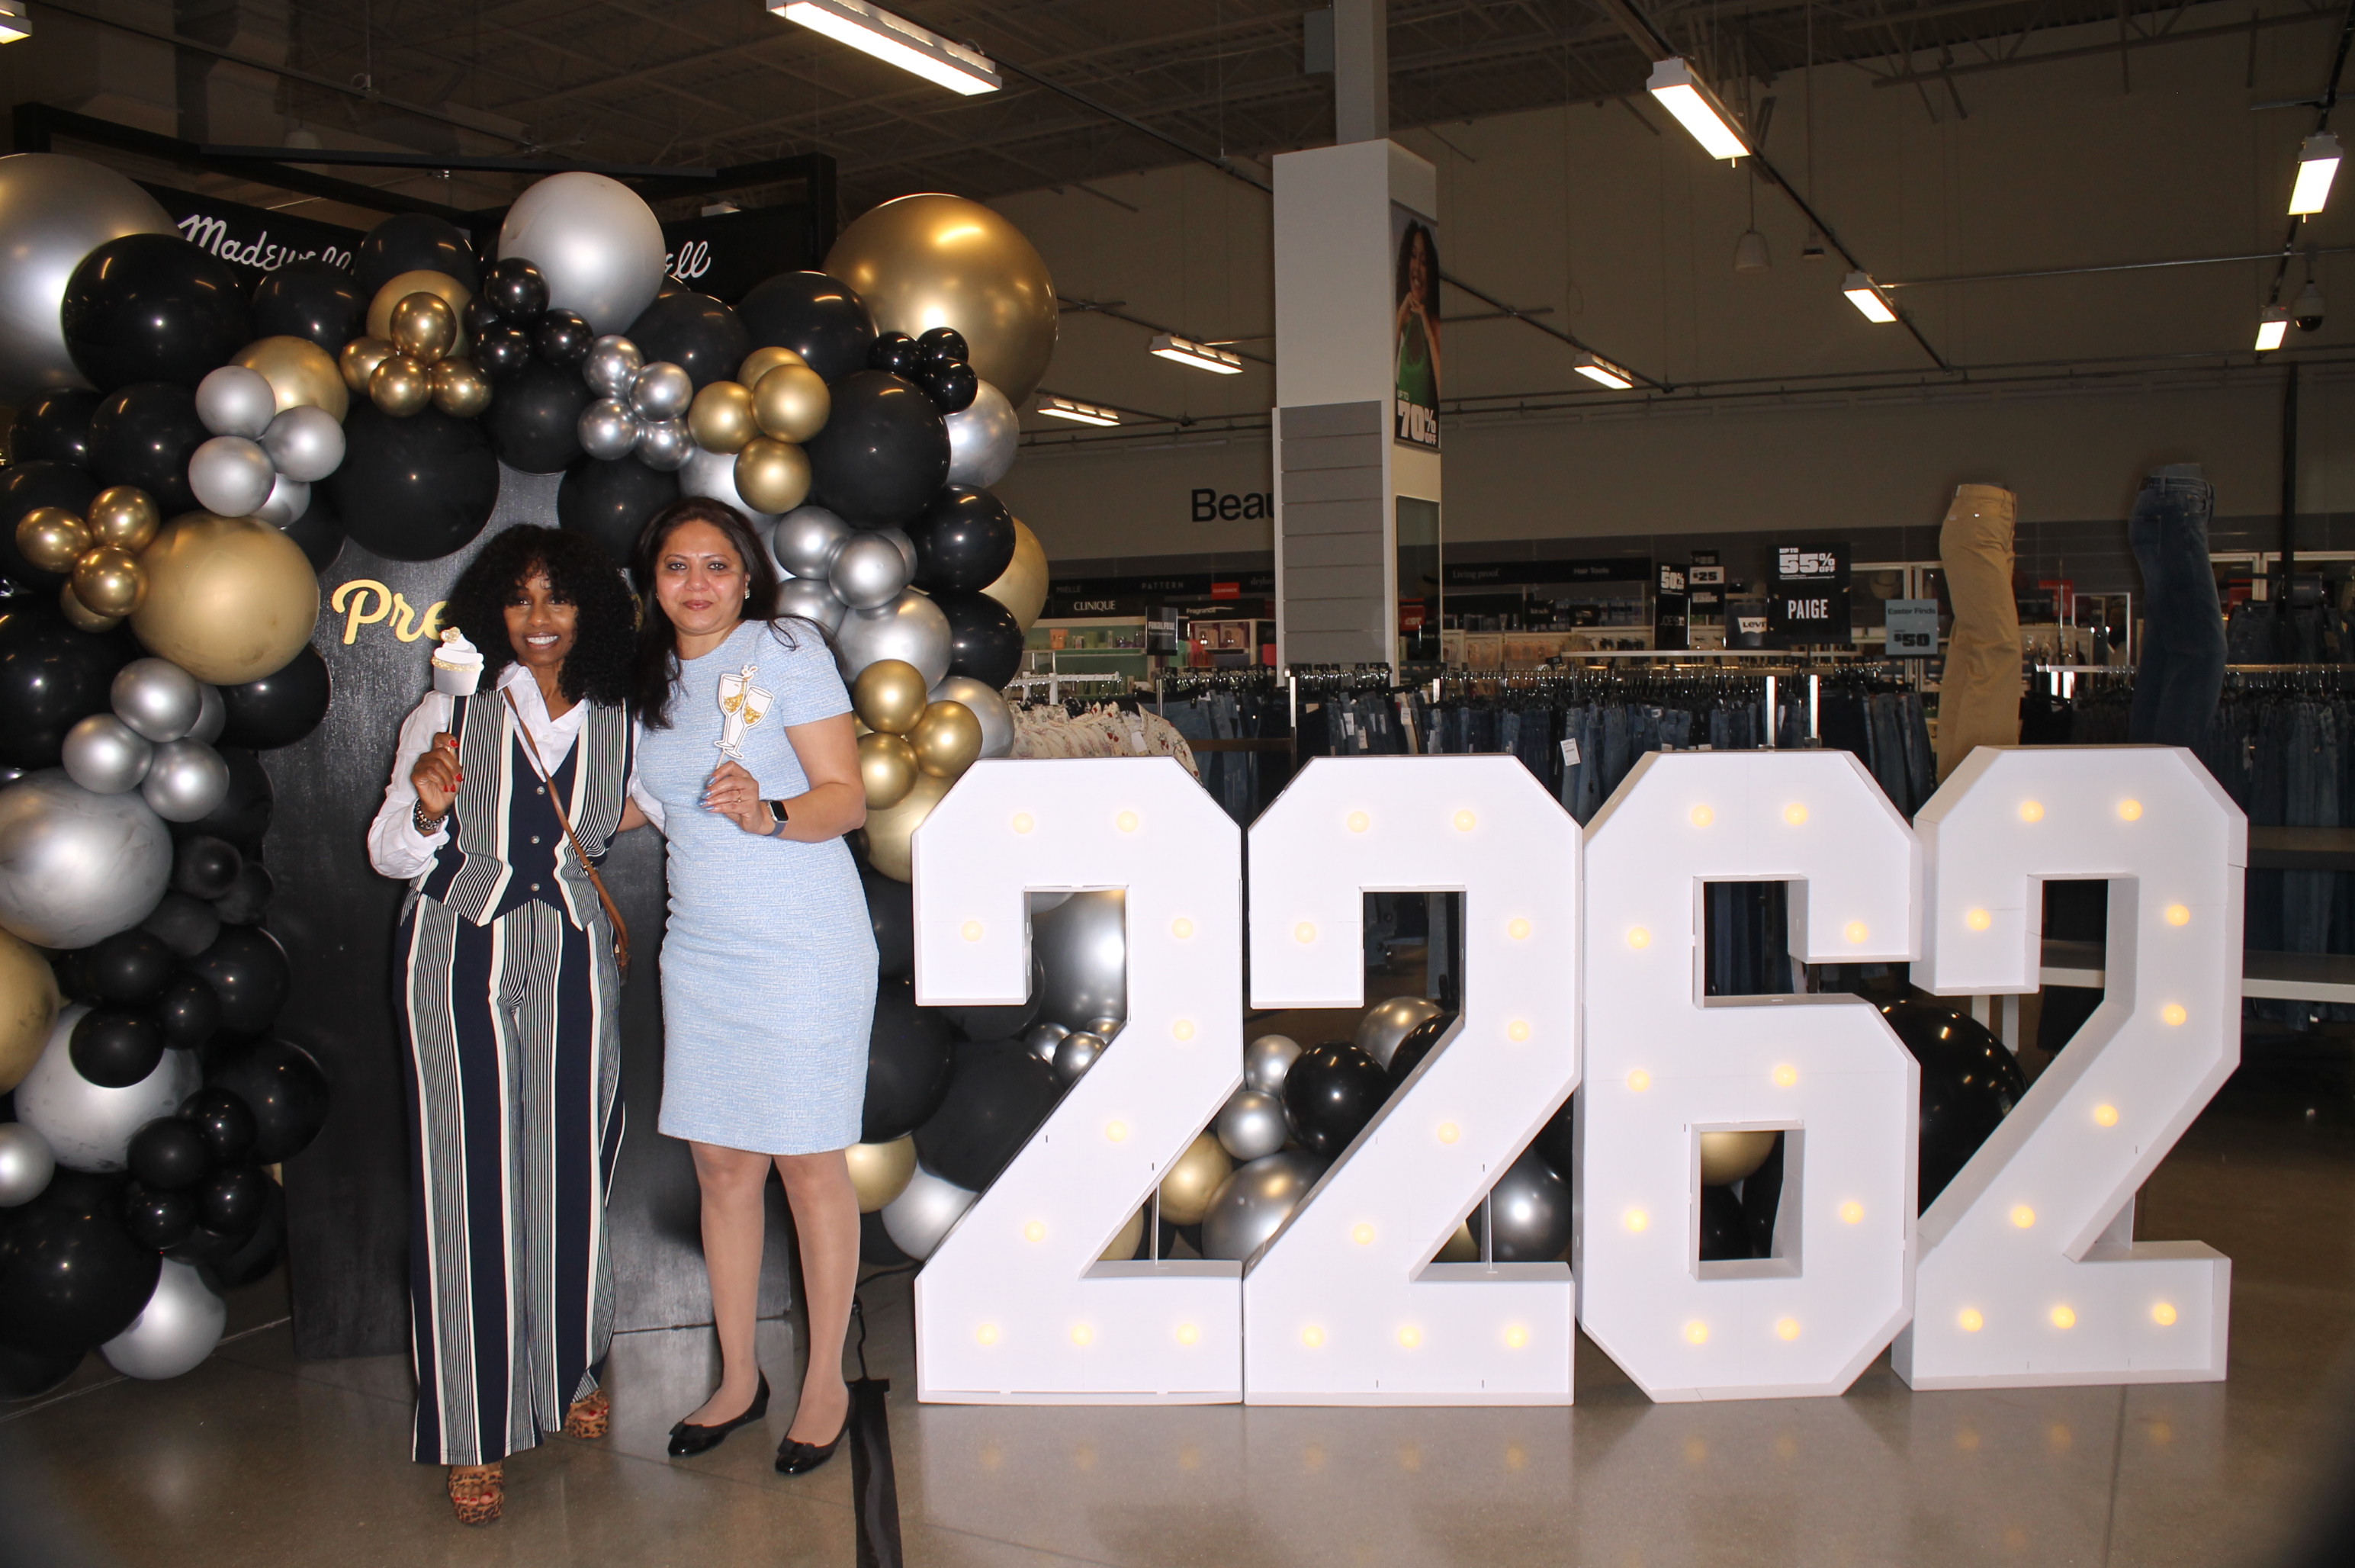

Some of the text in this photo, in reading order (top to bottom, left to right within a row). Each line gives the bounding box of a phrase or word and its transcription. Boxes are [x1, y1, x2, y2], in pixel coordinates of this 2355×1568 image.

[1055, 585, 1082, 593] MIELLE
[1141, 581, 1184, 590] PATTERN
[1074, 600, 1116, 611] CLINIQUE
[1788, 599, 1829, 619] PAIGE
[1186, 607, 1217, 615] Fragrance
[1894, 633, 1930, 647] $50
